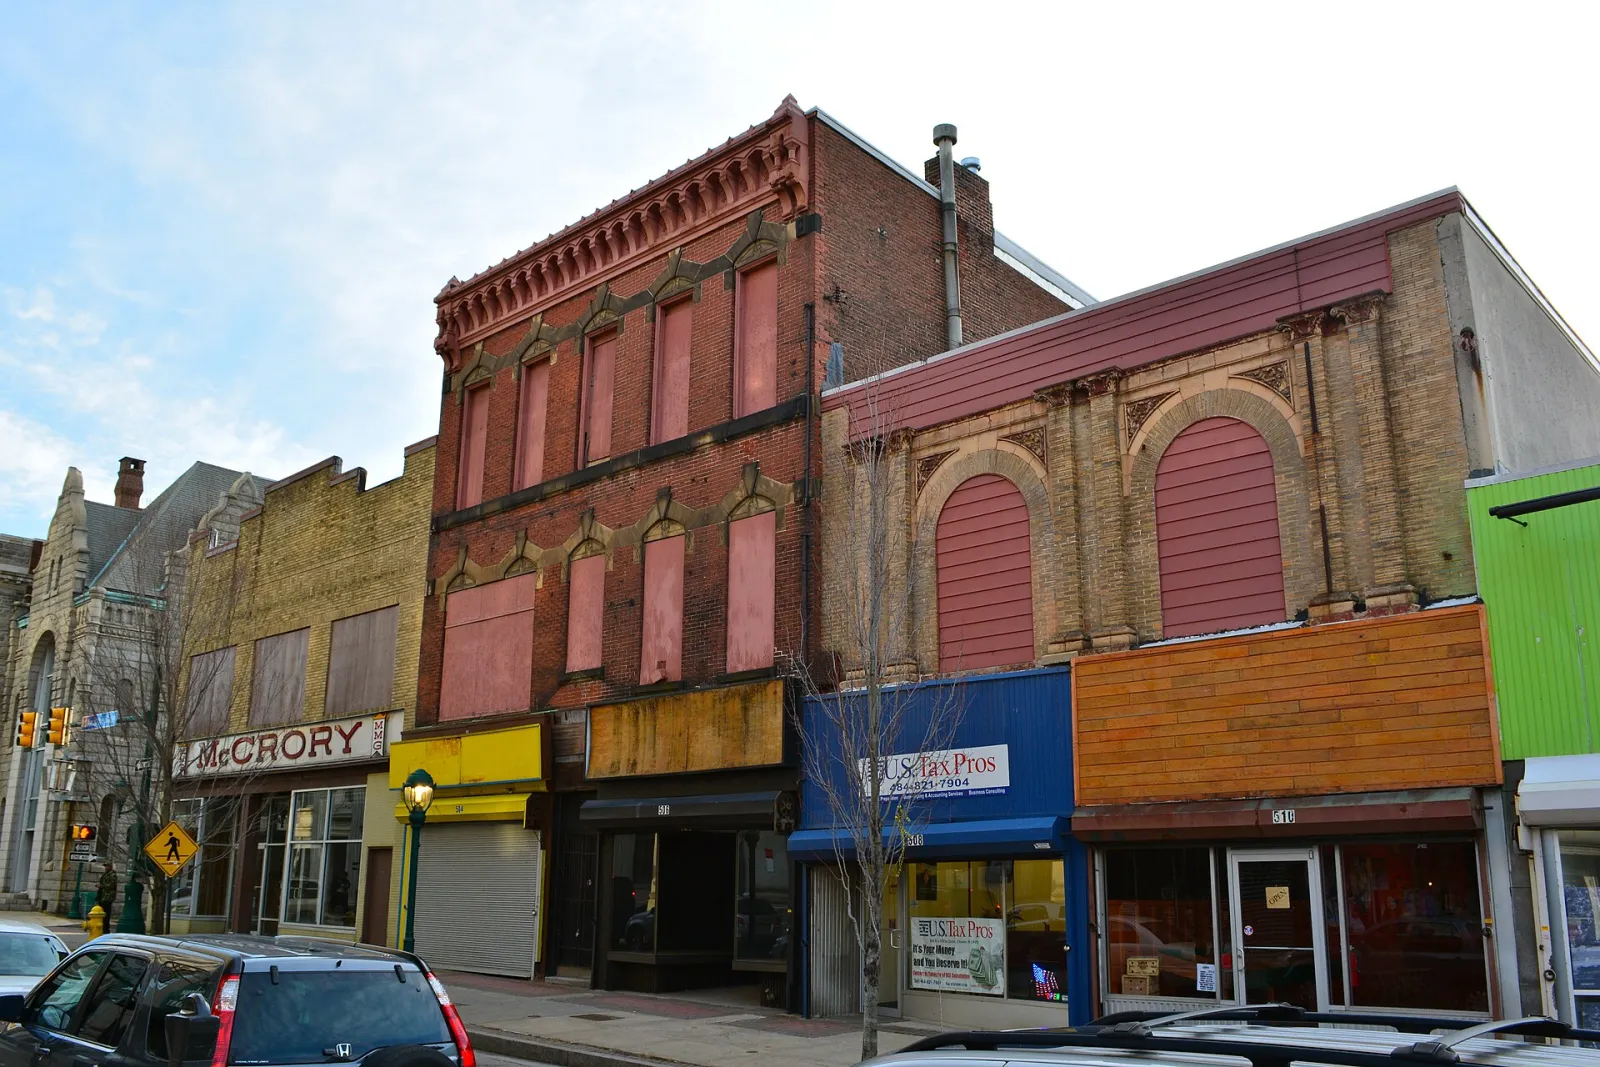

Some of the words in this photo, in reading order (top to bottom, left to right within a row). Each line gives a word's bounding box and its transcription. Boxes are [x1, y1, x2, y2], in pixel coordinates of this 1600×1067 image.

[196, 721, 363, 769] McCRORY
[919, 755, 950, 778] Tax
[953, 752, 996, 776] Pros
[928, 791, 948, 799] Accounting
[986, 787, 1006, 795] Consulting
[1273, 810, 1295, 823] 510
[907, 834, 923, 846] 508
[1268, 888, 1288, 905] OPEN
[929, 920, 948, 937] U.S.
[947, 920, 966, 938] Tax
[968, 920, 993, 939] Pros
[912, 944, 923, 954] It's
[922, 944, 936, 955] Your
[935, 945, 955, 956] Money
[913, 958, 924, 967] and
[924, 958, 936, 968] You
[936, 958, 960, 969] Deserve
